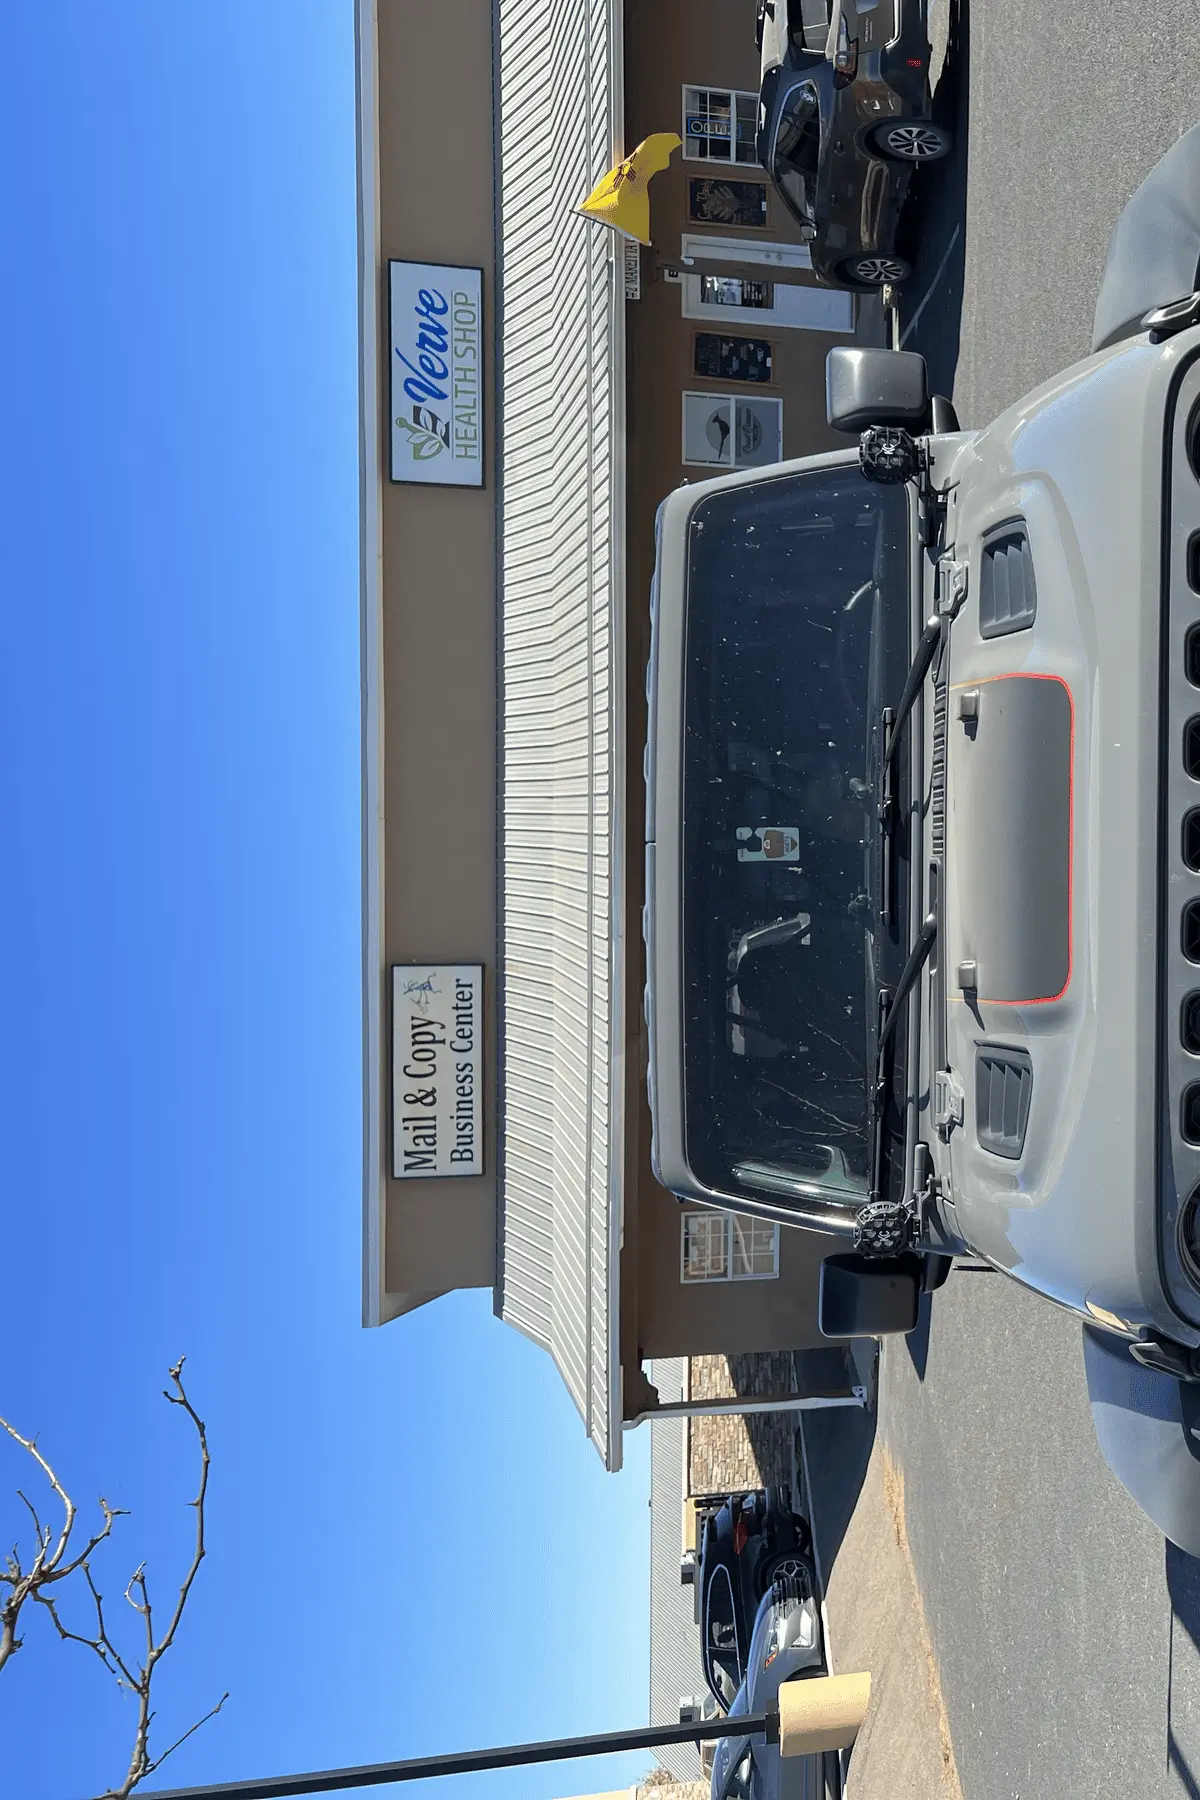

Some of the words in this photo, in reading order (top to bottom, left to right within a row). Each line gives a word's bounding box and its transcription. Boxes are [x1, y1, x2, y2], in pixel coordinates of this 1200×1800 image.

[395, 288, 449, 402] Verve
[453, 292, 476, 360] SHOP
[454, 367, 478, 460] HEALTH
[882, 443, 895, 454] KC
[402, 1016, 446, 1078] Copy
[450, 978, 474, 1053] Center
[403, 1087, 437, 1107] &
[450, 1062, 474, 1164] Business
[402, 1116, 437, 1172] Mail
[878, 1231, 890, 1242] KC
